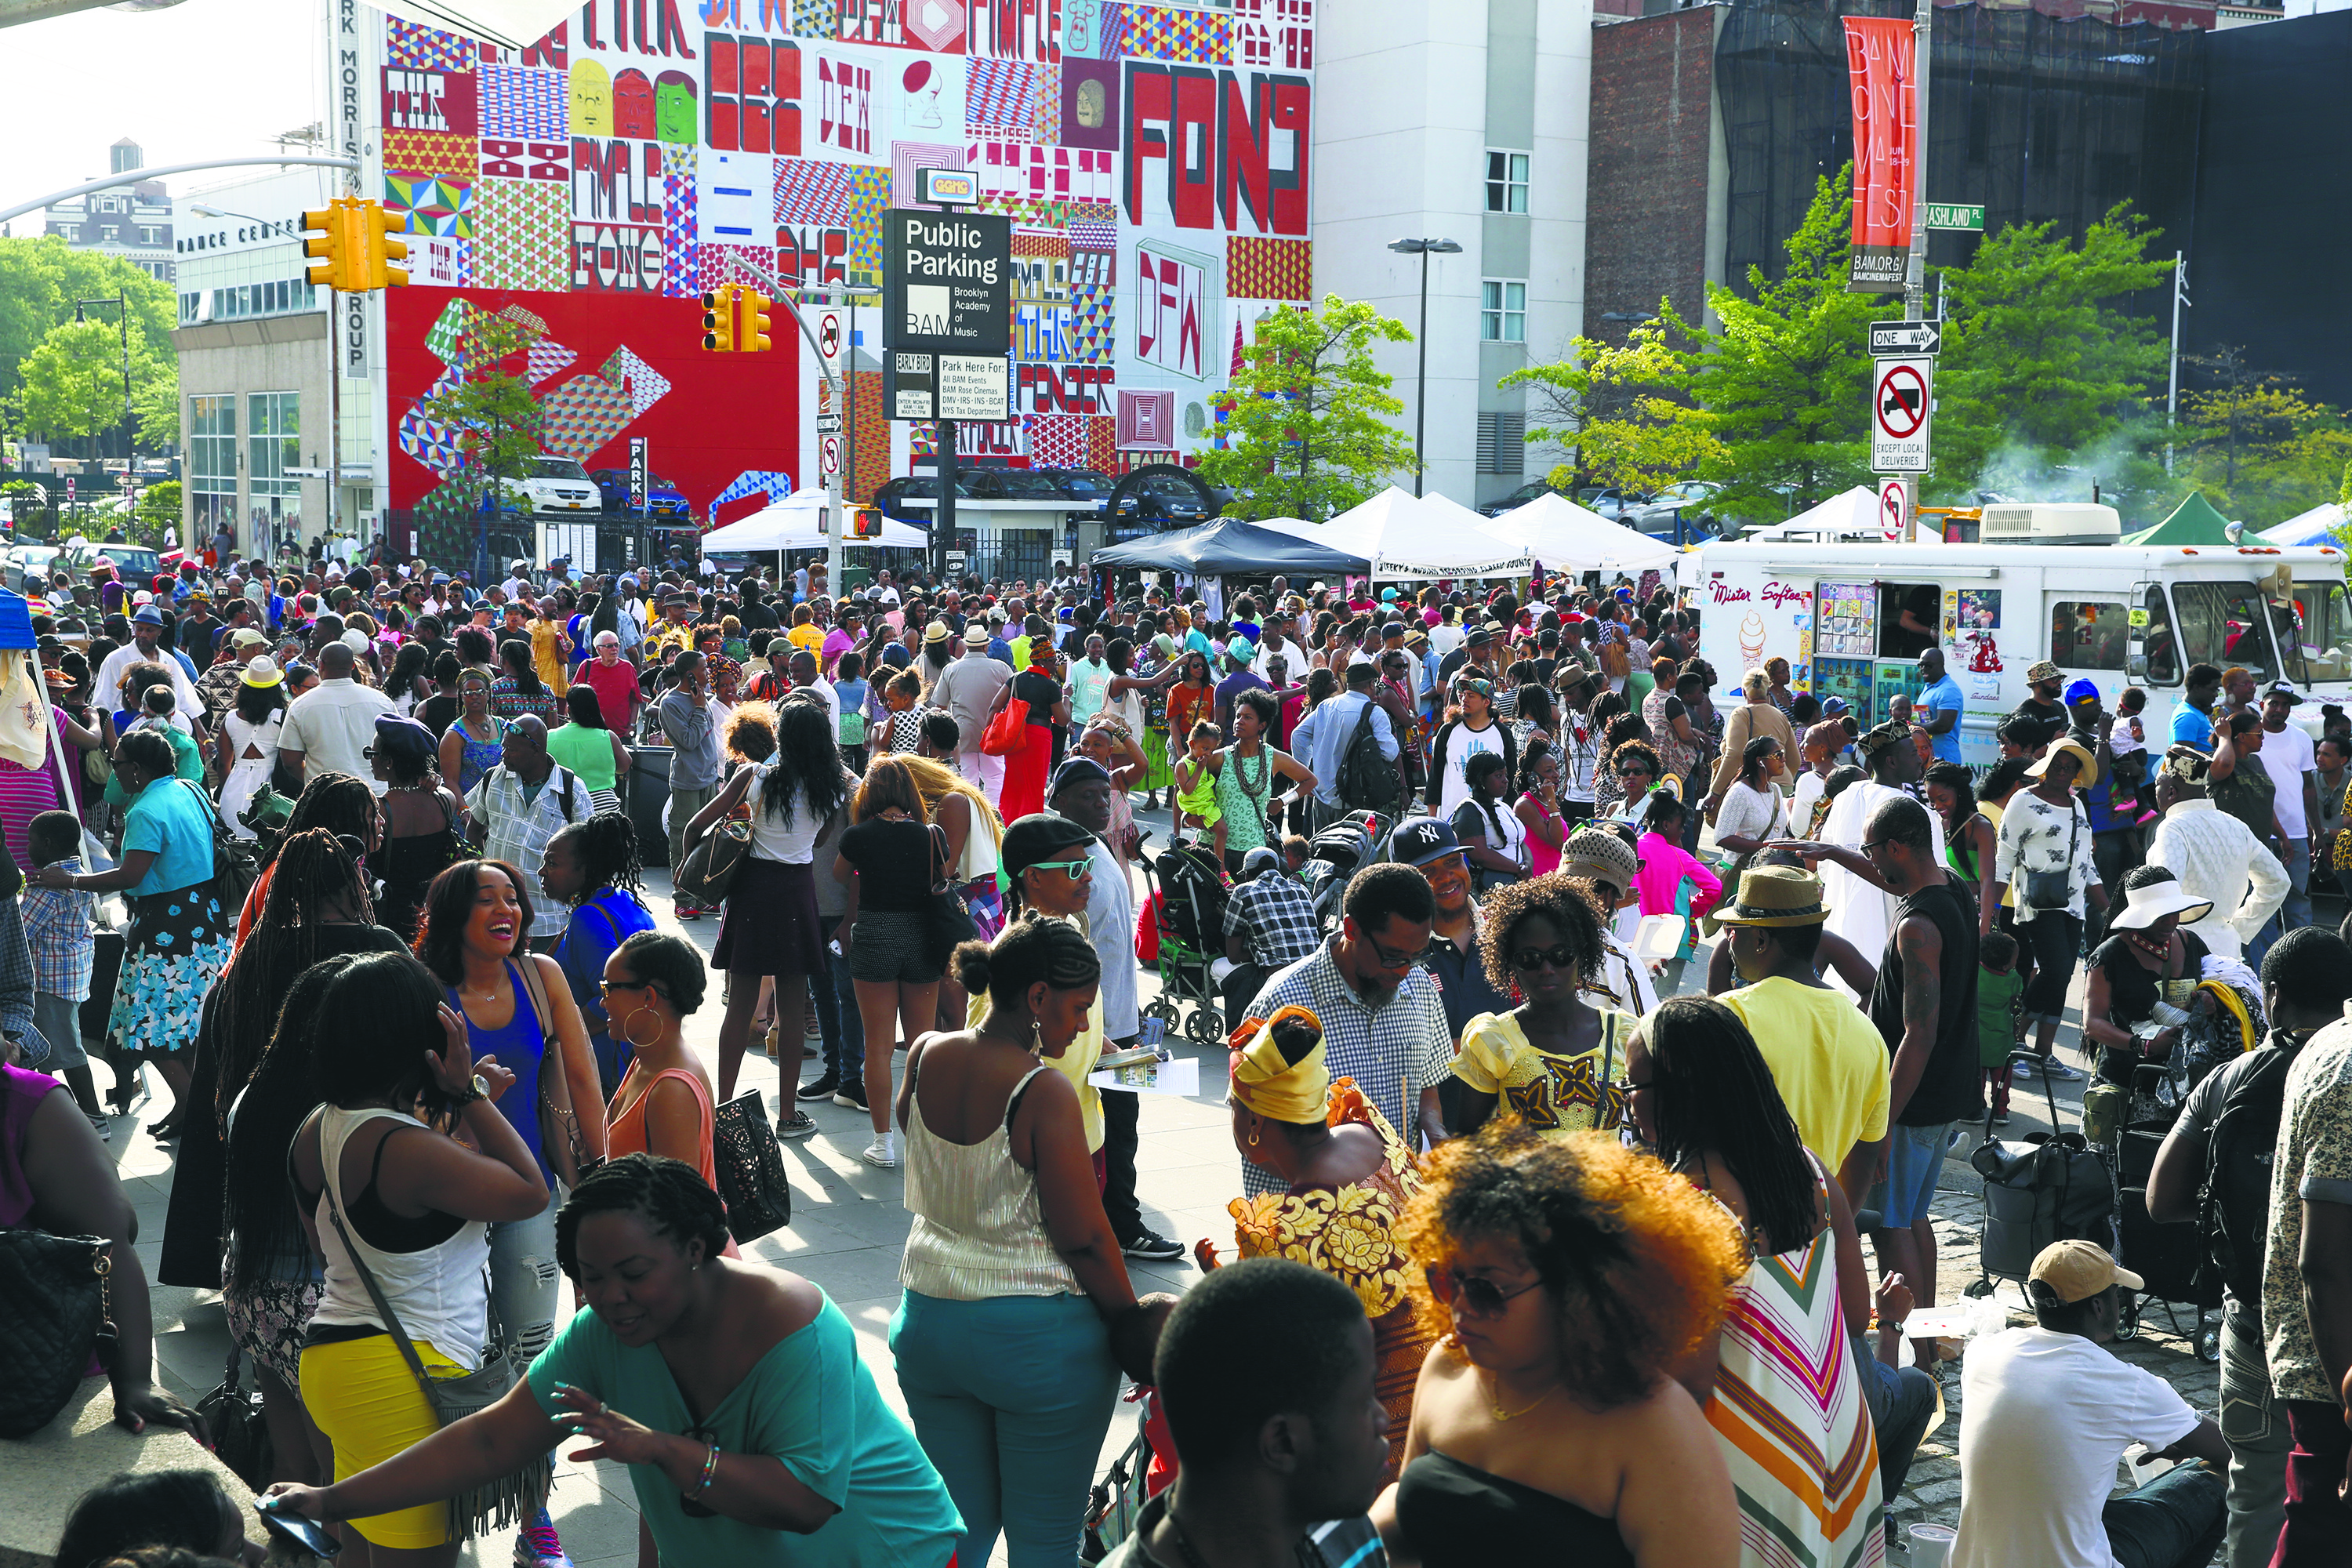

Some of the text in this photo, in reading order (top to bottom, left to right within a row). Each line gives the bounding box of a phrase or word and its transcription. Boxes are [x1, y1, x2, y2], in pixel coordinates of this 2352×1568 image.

[1845, 31, 1911, 77] BAM
[1853, 83, 1916, 128] CINE
[1889, 147, 1905, 155] JUN
[1928, 208, 1981, 226] ASHLAND PL
[177, 231, 227, 253] DANCE
[907, 220, 982, 249] Public
[907, 249, 998, 285] Parking
[1853, 255, 1905, 273] BAM.ORG/
[1853, 271, 1903, 281] BAMCINEMAFEST
[954, 287, 989, 299] Brooklyn
[954, 300, 991, 313] Academy
[907, 313, 950, 336] BAM
[954, 314, 963, 322] of
[349, 291, 363, 366] ROUP
[954, 327, 978, 337] Music
[1875, 331, 1932, 344] ONE WAY
[898, 354, 931, 370] EARLY BIRD
[942, 361, 1004, 373] Park Here For:
[967, 407, 1001, 416] Department
[1876, 444, 1924, 453] EXCEPT LOCAL
[1882, 456, 1919, 466] DELIVERIES
[630, 445, 642, 494] PARK
[1708, 580, 1802, 610] Mister Softee
[1970, 692, 2000, 702] Sundaes
[1417, 823, 1440, 844] NY
